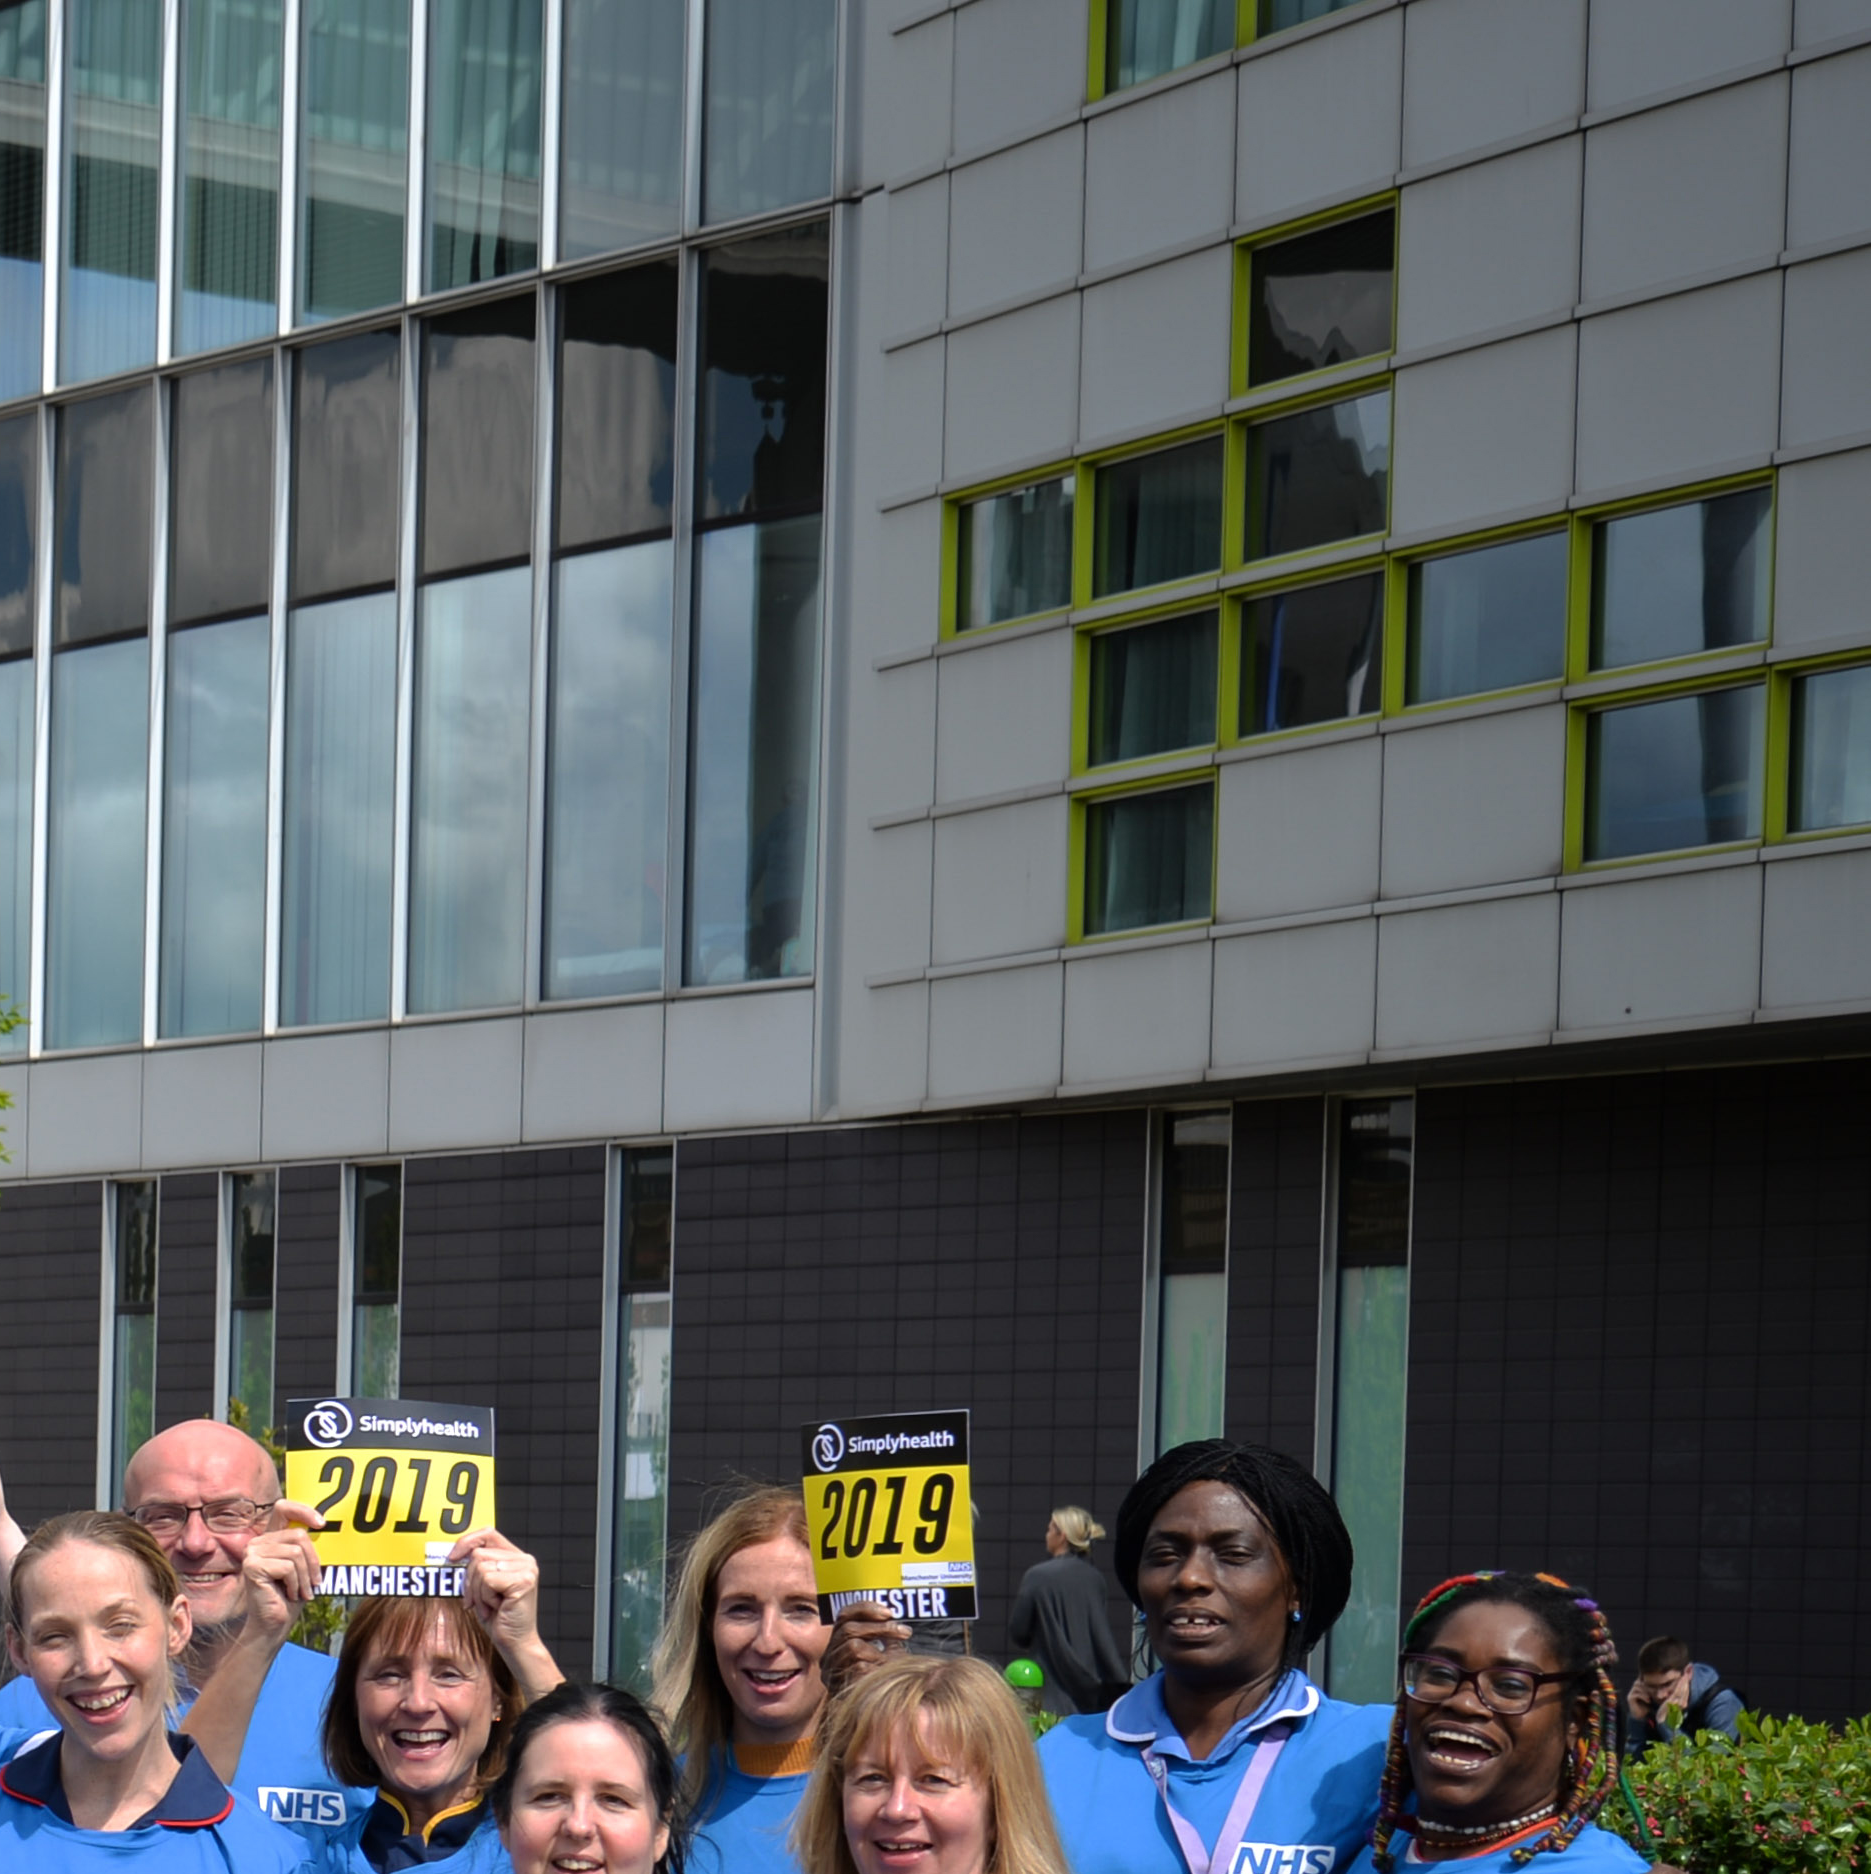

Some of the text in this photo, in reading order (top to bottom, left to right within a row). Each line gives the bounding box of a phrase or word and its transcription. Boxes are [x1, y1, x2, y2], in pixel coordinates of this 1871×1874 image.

[359, 1415, 479, 1438] Simplyhealth
[848, 1430, 954, 1455] Simplyhealth
[307, 1455, 480, 1535] 2019
[820, 1472, 955, 1560] 2019
[266, 1790, 342, 1822] NHS
